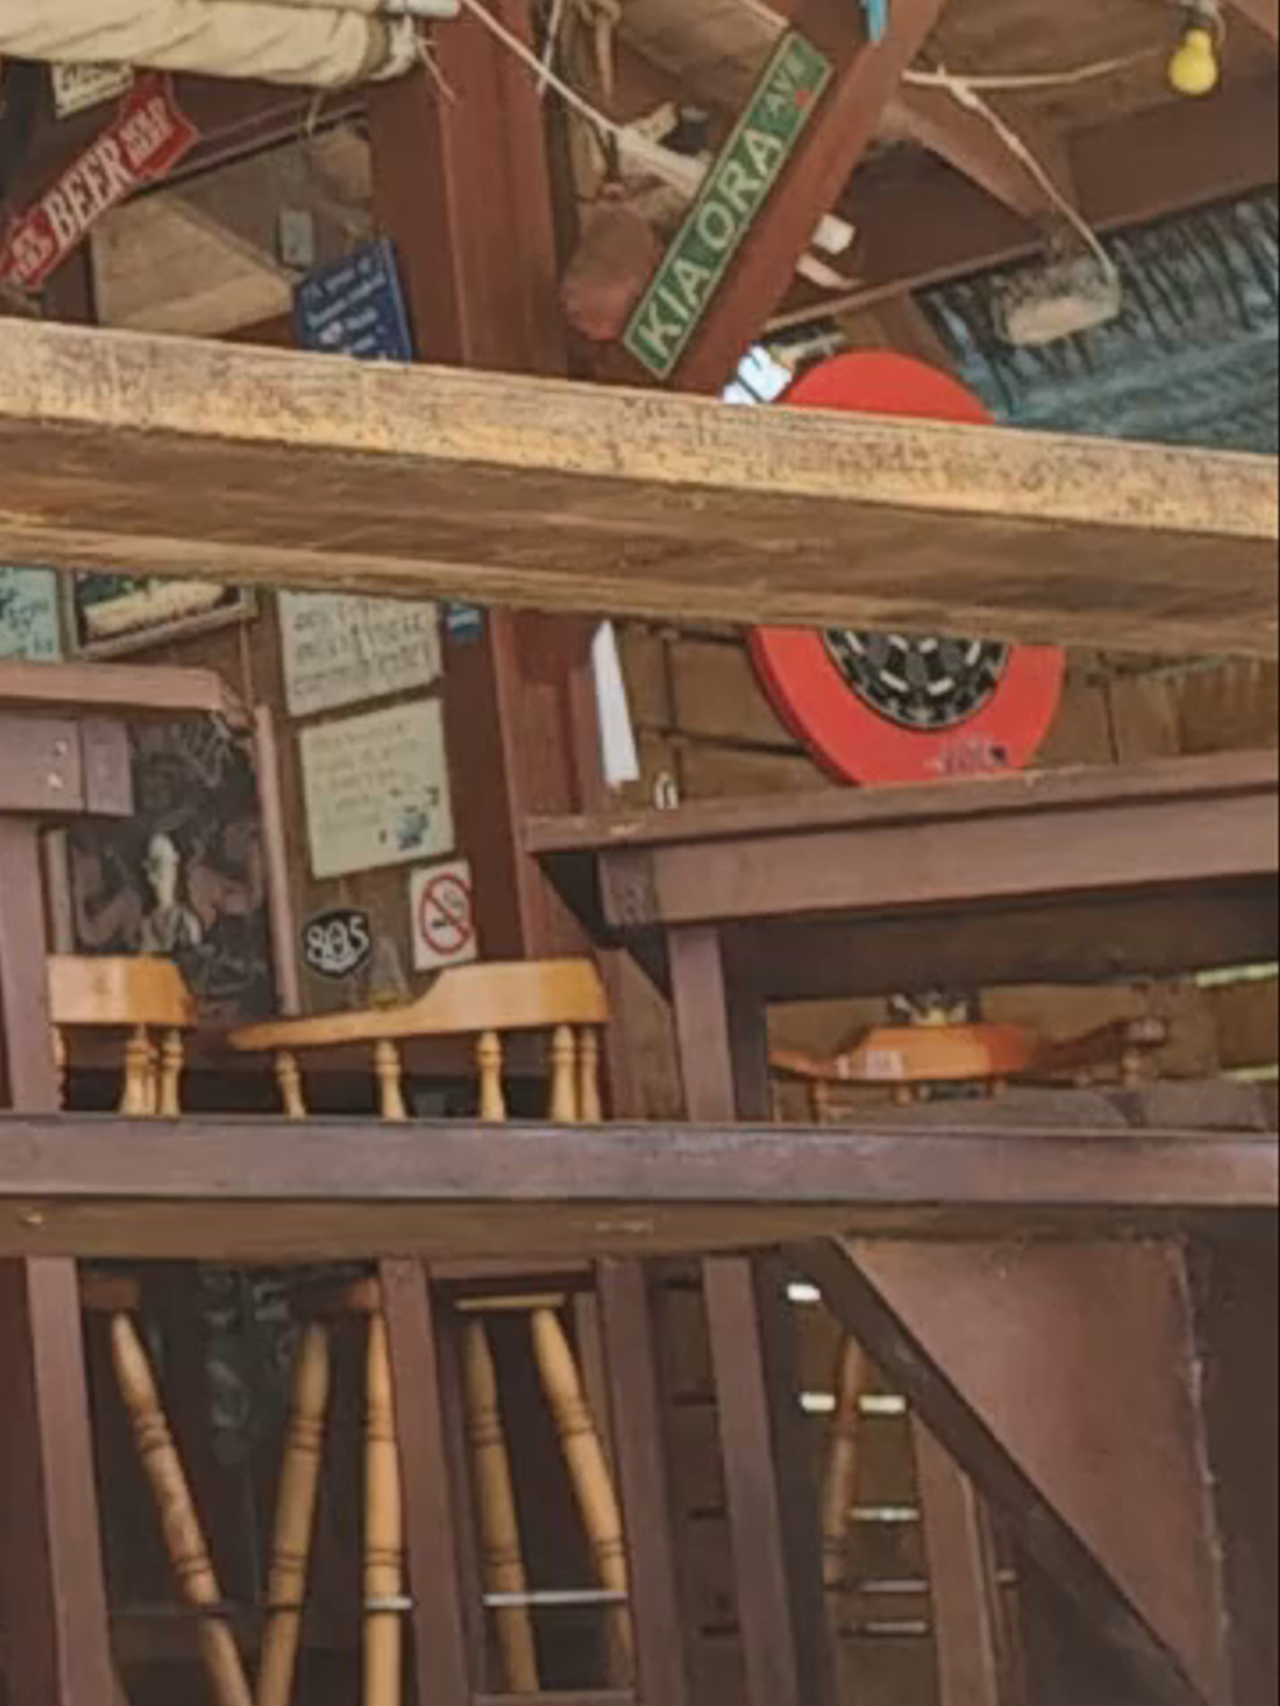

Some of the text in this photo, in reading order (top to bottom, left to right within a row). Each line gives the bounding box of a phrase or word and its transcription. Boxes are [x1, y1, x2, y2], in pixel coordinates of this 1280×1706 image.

[42, 136, 134, 248] BEER
[638, 258, 711, 359] KIA
[696, 128, 783, 250] ORA
